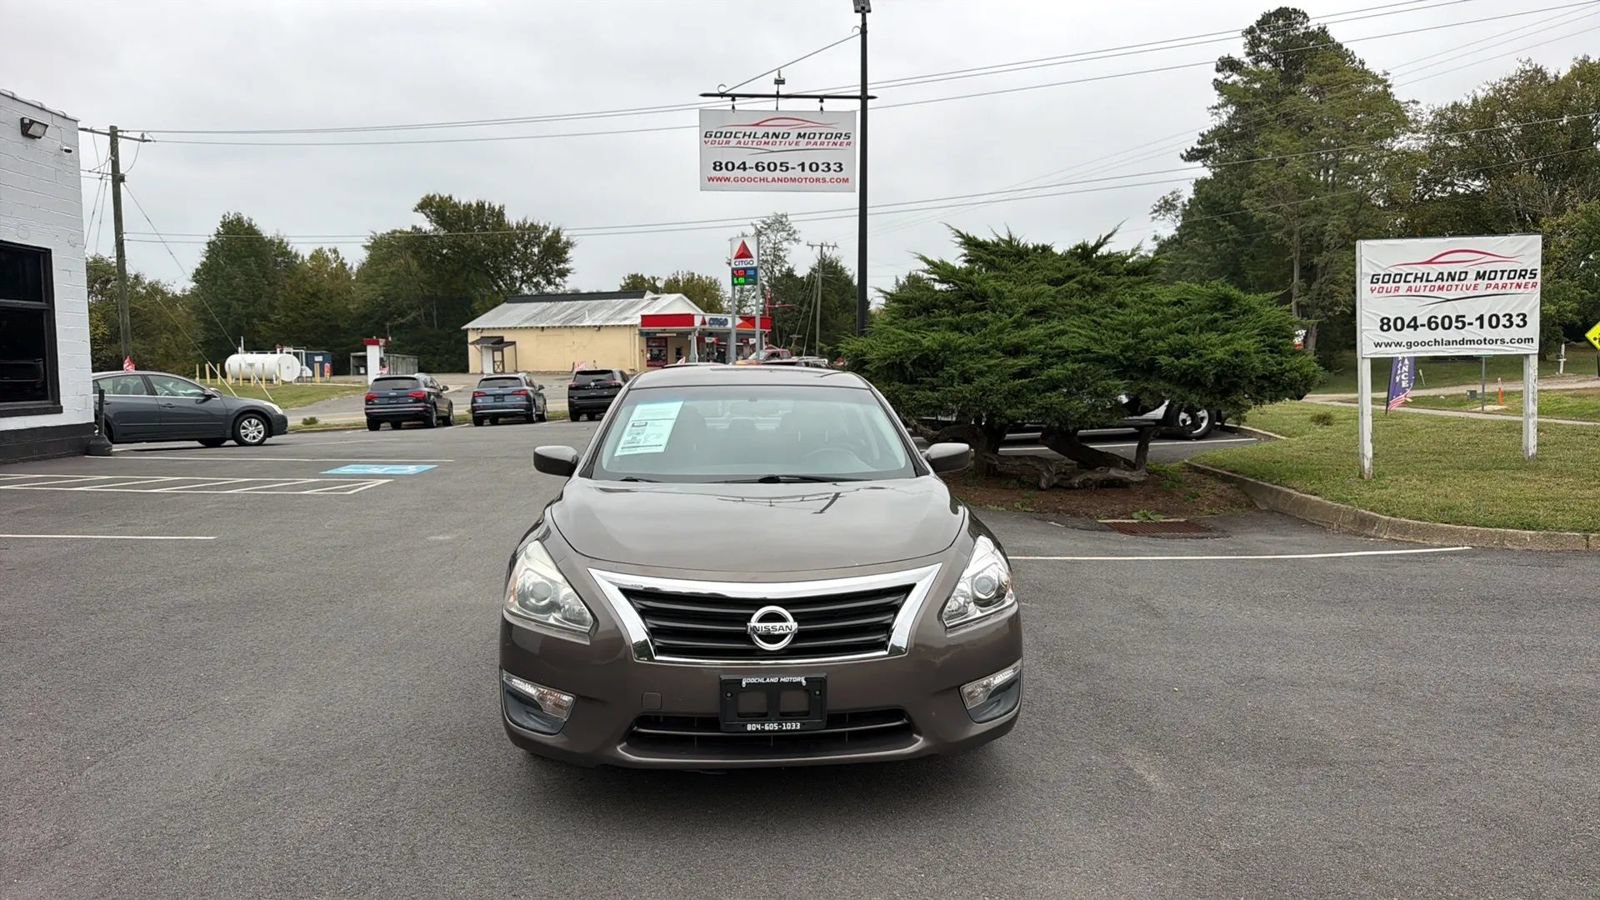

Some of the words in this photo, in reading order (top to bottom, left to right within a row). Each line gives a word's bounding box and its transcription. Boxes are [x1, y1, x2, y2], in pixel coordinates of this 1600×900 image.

[704, 131, 790, 140] GOOCHLAND
[796, 132, 851, 140] MOTORS
[712, 161, 844, 172] 804-605-1033
[1370, 271, 1468, 284] GOOCHLAND
[1474, 268, 1538, 282] MOTORS
[1406, 284, 1480, 293] AUTOMOTIVE
[1485, 282, 1538, 290] PARTNER
[1379, 312, 1528, 332] 804-605-1033
[1374, 336, 1534, 349] www.goochlandmotors.com
[752, 624, 793, 632] NISSAN
[747, 722, 800, 731] 804-605-1033
